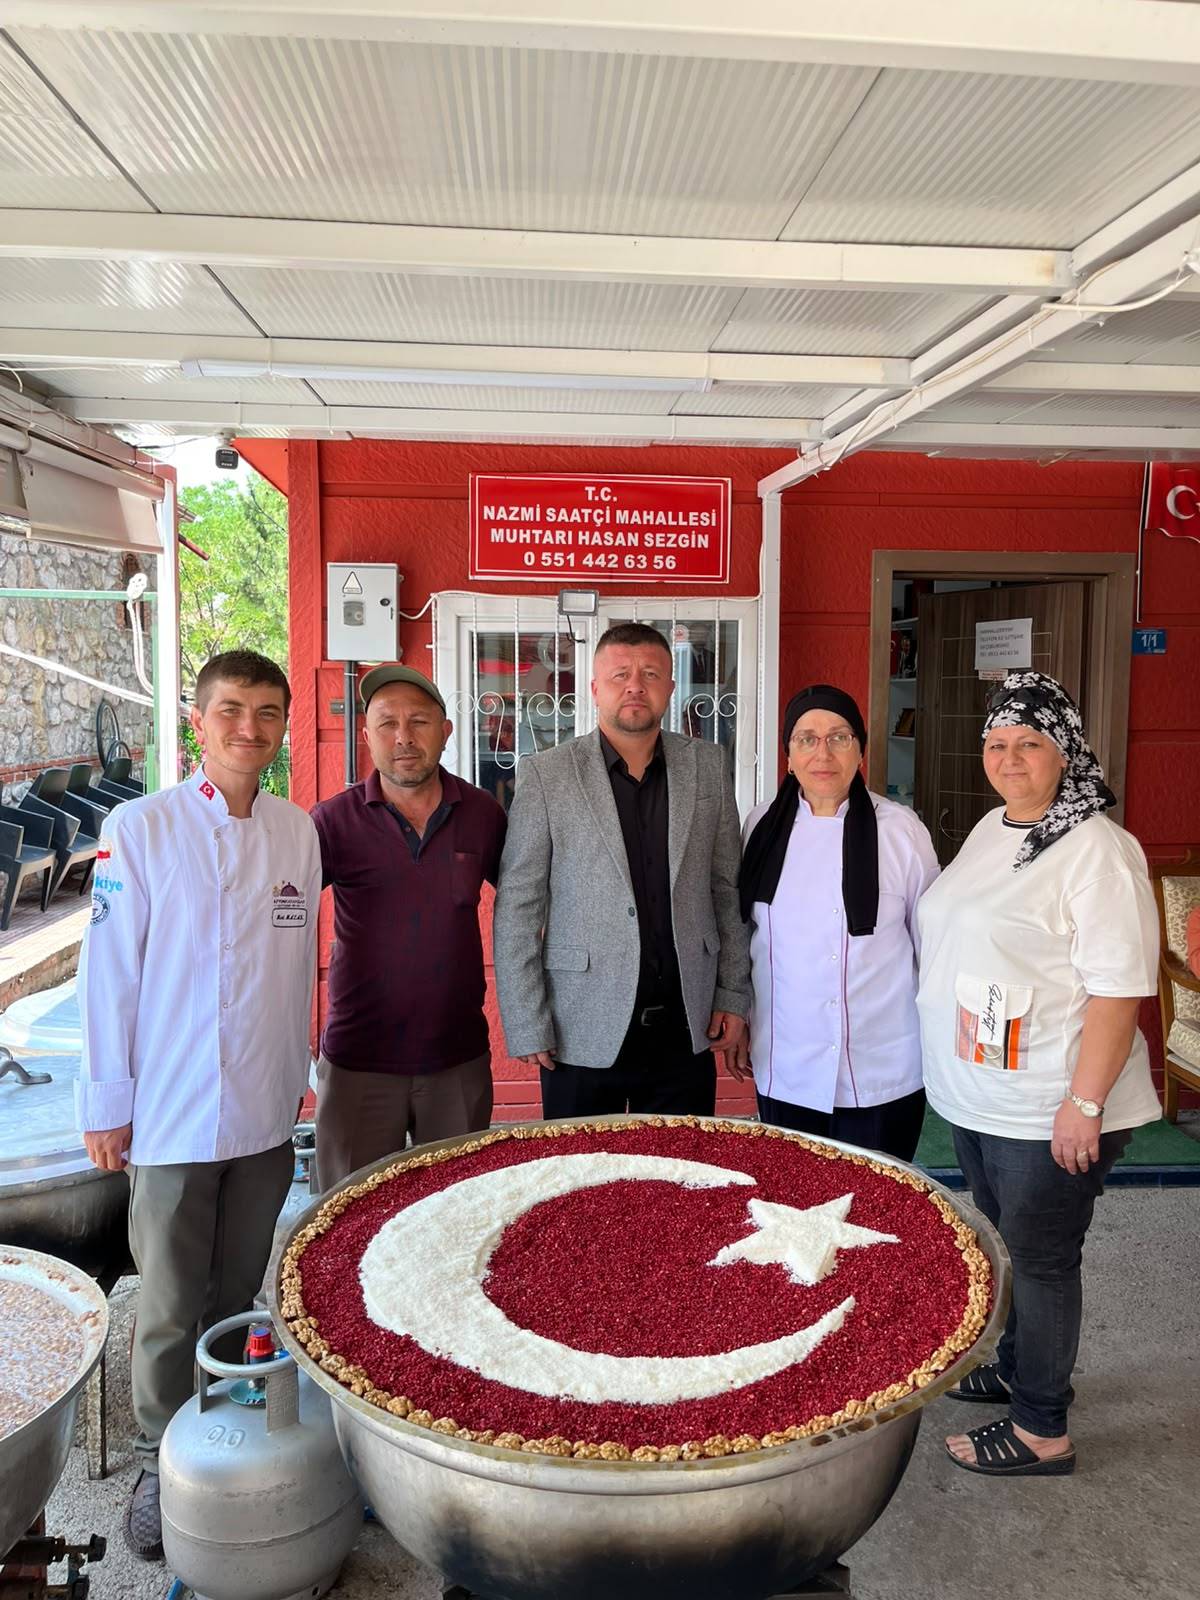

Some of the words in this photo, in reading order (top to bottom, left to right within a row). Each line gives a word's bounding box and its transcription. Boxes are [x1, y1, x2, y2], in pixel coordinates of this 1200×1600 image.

[585, 487, 617, 501] T.C.
[483, 504, 541, 522] NAZMİ
[546, 506, 611, 527] SAATÇİ
[616, 509, 717, 527] MAHALLESİ
[490, 528, 572, 545] MUHTARI
[578, 531, 638, 547] HASAN
[643, 531, 709, 548] SEZGİN
[524, 551, 535, 566] 0
[541, 552, 575, 567] 551
[583, 553, 619, 568] 442
[624, 555, 648, 569] 63
[653, 556, 677, 570] 56
[1141, 634, 1157, 647] 1/1
[95, 876, 123, 893] kiye
